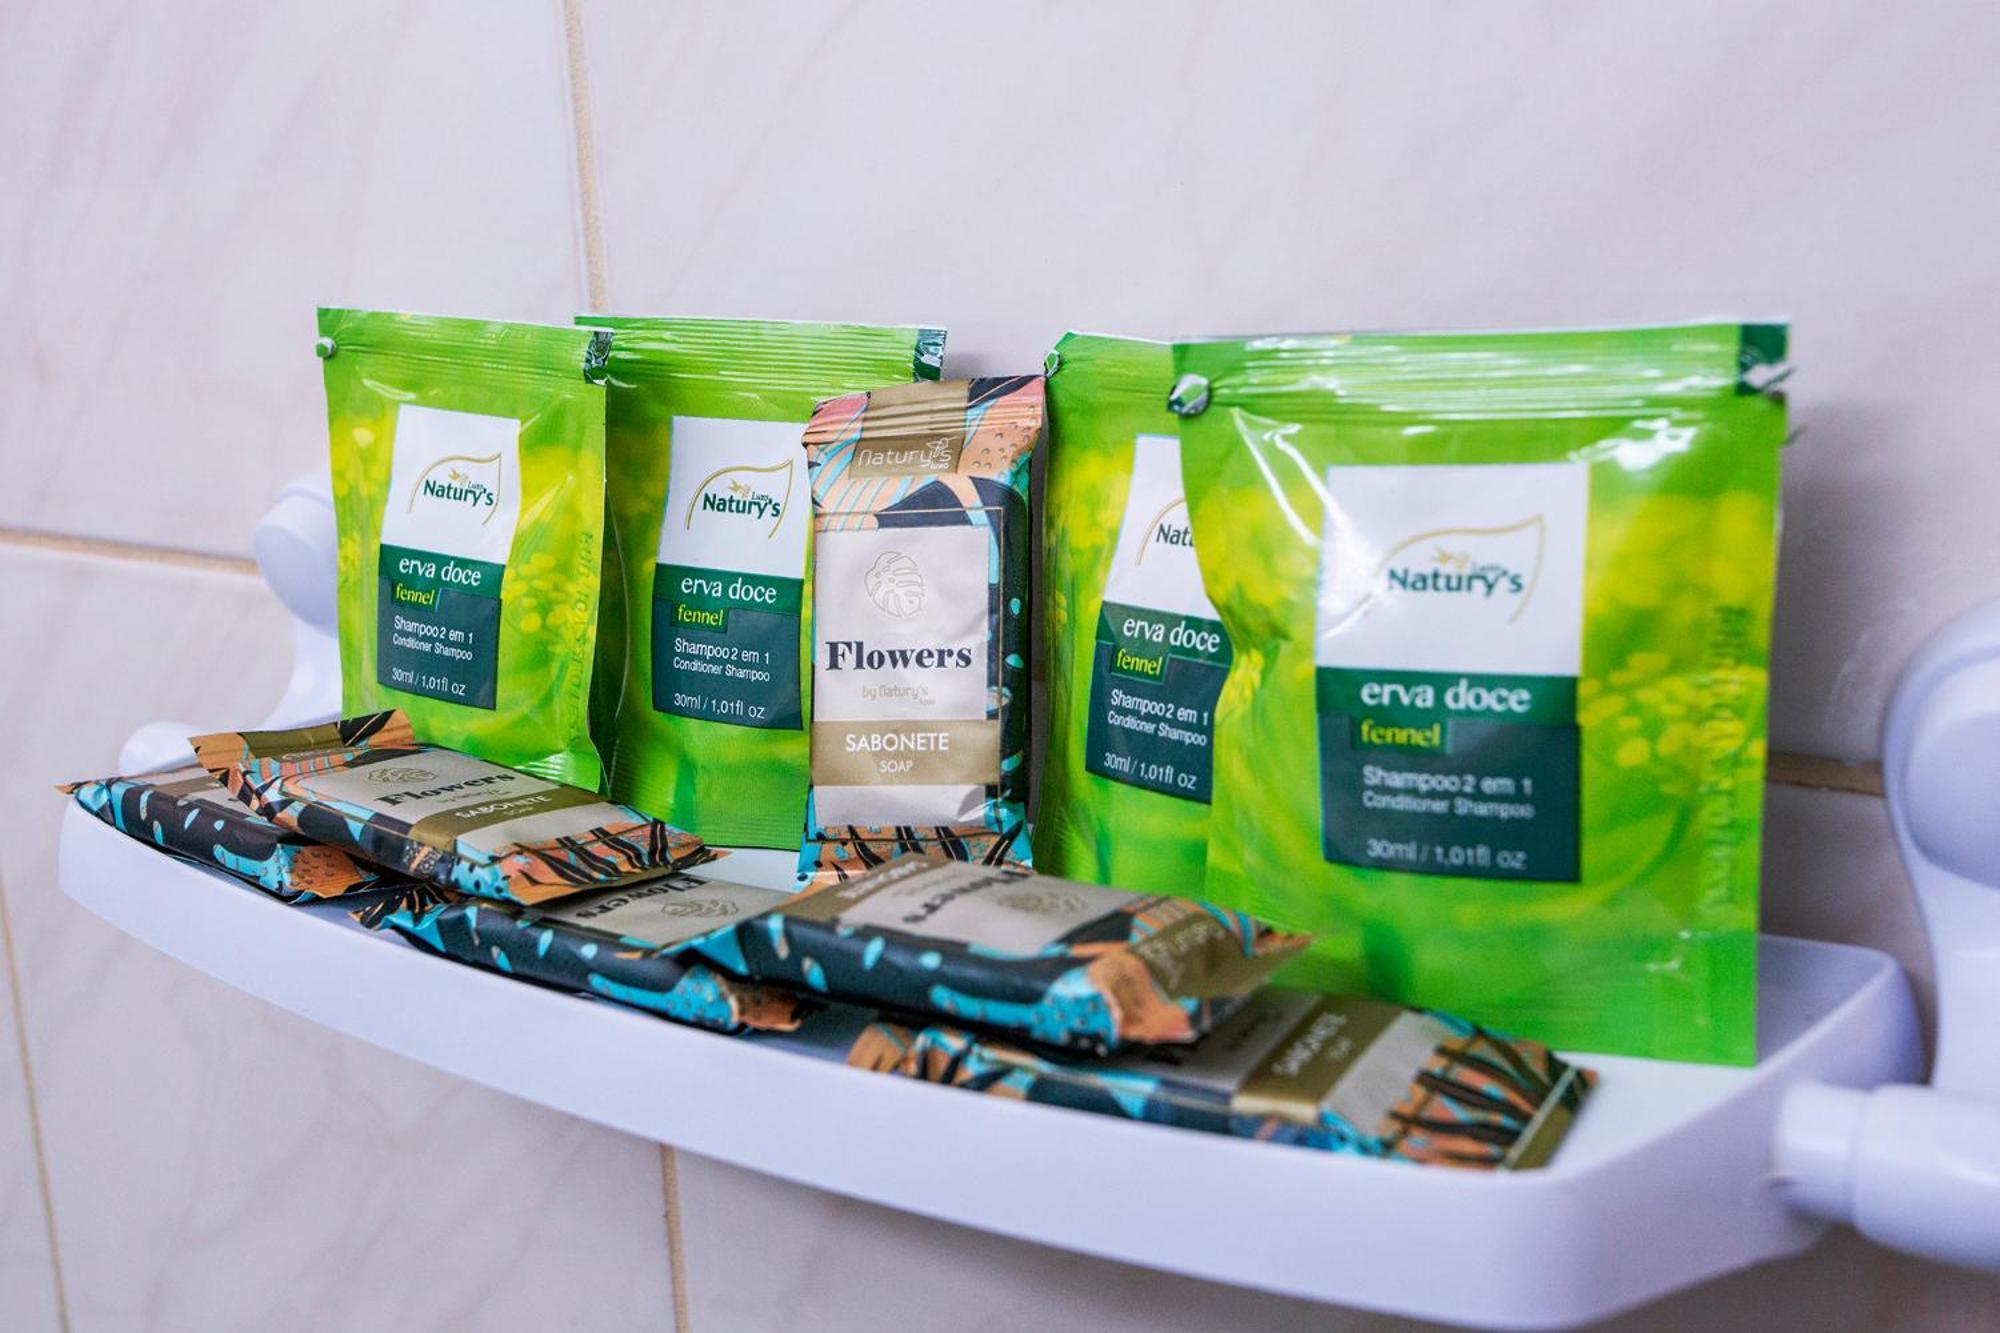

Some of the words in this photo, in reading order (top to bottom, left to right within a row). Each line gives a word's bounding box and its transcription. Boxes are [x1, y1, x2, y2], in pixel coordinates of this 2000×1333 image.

[423, 479, 494, 507] Natury's
[702, 493, 781, 520] Natury's
[399, 556, 436, 579] erva
[440, 560, 481, 587] doce
[1388, 567, 1523, 597] Natury's
[396, 583, 434, 605] fennel
[681, 577, 722, 598] erva
[729, 578, 776, 604] doce
[677, 604, 723, 626] fennel
[392, 632, 432, 652] Conditioner
[434, 641, 473, 661] Shampoo
[448, 631, 465, 642] em
[468, 632, 473, 644] 1
[1123, 616, 1163, 643] erva
[1169, 620, 1220, 652] doce
[741, 650, 759, 663] em
[764, 651, 769, 665] 1
[825, 641, 972, 671] Flowers
[1116, 649, 1163, 676] fennel
[673, 657, 722, 676] Conditioner
[725, 664, 770, 683] Shampoo
[451, 683, 466, 696] oz
[1361, 682, 1434, 708] erva
[1445, 678, 1532, 712] doce
[674, 692, 701, 711] 30ml
[748, 705, 765, 720] oz
[1177, 708, 1197, 722] em
[1202, 710, 1208, 726] 1
[1107, 711, 1156, 734] Conditioner
[1158, 721, 1208, 746] Shampoo
[1361, 719, 1440, 747] fennel
[845, 733, 949, 752] SABONETE
[879, 760, 914, 774] SOAP
[1104, 753, 1130, 774] 30ml
[1178, 773, 1197, 790] oz
[375, 773, 516, 807] Flowers
[1480, 777, 1515, 794] em
[1522, 777, 1532, 796] 1
[1453, 798, 1536, 821] Shampoo
[1367, 838, 1416, 861] 30ml
[1496, 849, 1528, 870] oz
